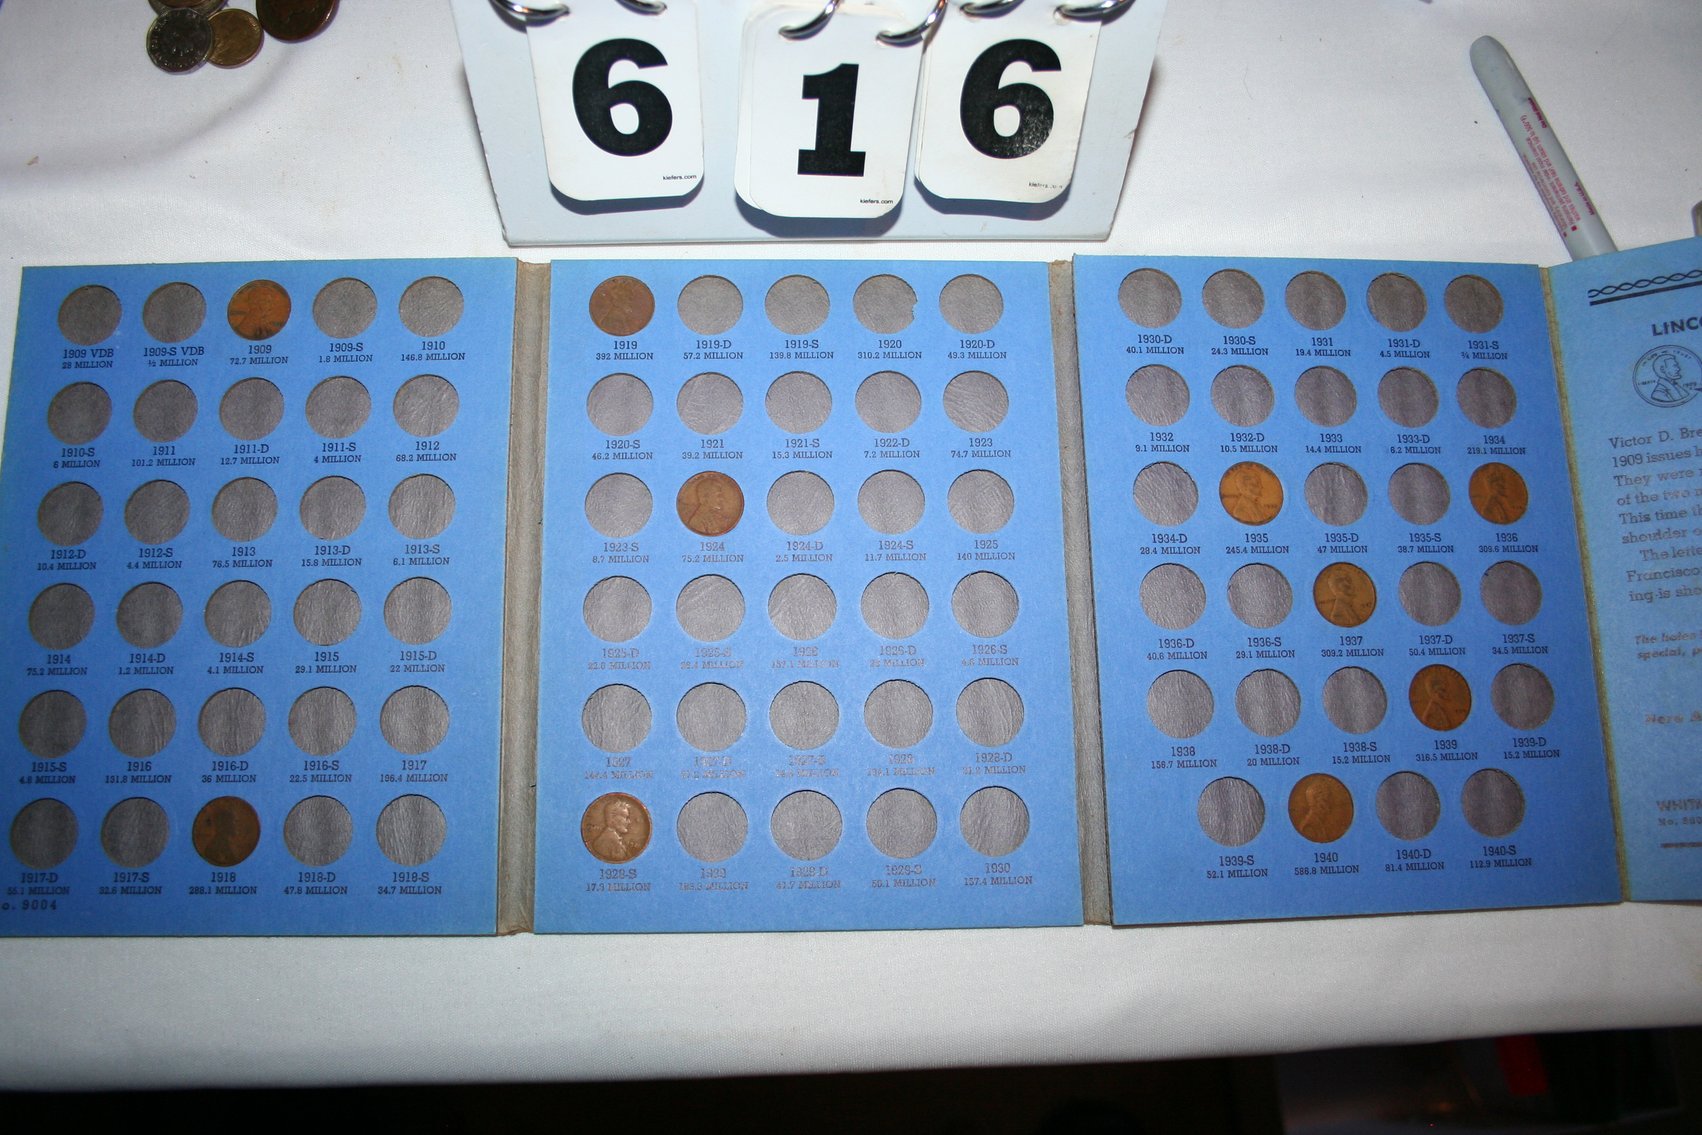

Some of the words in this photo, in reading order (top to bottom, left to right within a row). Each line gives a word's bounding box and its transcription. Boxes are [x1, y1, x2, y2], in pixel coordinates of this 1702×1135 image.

[572, 38, 673, 157] 6
[797, 63, 867, 177] 1
[960, 38, 1062, 159] 6
[1651, 316, 1702, 337] LINC
[614, 340, 638, 350] 1919
[696, 339, 732, 350] 1919-D
[784, 338, 820, 350] 1919-S
[878, 339, 903, 349] 1920
[959, 339, 996, 350] 1920-D
[1137, 334, 1173, 344] 1930-D
[1222, 335, 1257, 346] 1930-S
[1311, 336, 1333, 347] 1931
[1387, 338, 1421, 349] 1931-D
[1467, 339, 1500, 350] 1931-S
[144, 346, 178, 357] 1909-S
[180, 345, 205, 356] VDB
[248, 344, 273, 355] 1909
[329, 342, 364, 353] 1909-S
[421, 340, 446, 351] 1910
[1126, 346, 1143, 354] 40.1
[1146, 346, 1184, 354] MILLION
[1211, 347, 1228, 355] 24.3
[1230, 347, 1269, 356] MILLION
[63, 348, 88, 360] 1909
[90, 348, 114, 358] VDB
[401, 353, 423, 362] 146.8
[425, 352, 466, 361] MILLION
[596, 352, 611, 361] 392
[614, 352, 654, 360] MILLION
[683, 352, 701, 360] 57.2
[704, 351, 744, 360] MILLION
[770, 351, 792, 360] 139.8
[794, 351, 834, 359] MILLION
[857, 351, 880, 359] 310.2
[882, 351, 922, 359] MILLION
[947, 351, 965, 359] 49.3
[967, 351, 1007, 359] MILLION
[229, 357, 247, 365] 72.7
[248, 356, 289, 365] MILLION
[874, 437, 911, 448] 1922-D
[968, 437, 994, 448] 1923
[1150, 431, 1174, 442] 1932
[1230, 432, 1265, 443] 1932-D
[1319, 432, 1344, 444] 1933
[1396, 433, 1431, 444] 1933-D
[1482, 434, 1506, 446] 1934
[1608, 435, 1652, 449] Victor
[1658, 430, 1674, 442] D.
[234, 443, 270, 455] 1911-D
[322, 441, 357, 453] 1911-S
[415, 440, 440, 452] 1912
[605, 438, 641, 450] 1920-S
[700, 438, 724, 449] 1921
[785, 438, 821, 449] 1921-S
[1220, 444, 1238, 453] 10.5
[1239, 444, 1278, 453] MILLION
[62, 446, 96, 458] 1910-S
[153, 445, 176, 456] 1911
[131, 458, 154, 467] 101.2
[156, 457, 196, 466] MILLION
[220, 457, 238, 466] 12.7
[240, 456, 280, 465] MILLION
[395, 454, 414, 462] 68.2
[416, 453, 457, 462] MILLION
[1612, 453, 1643, 468] 1909
[1646, 452, 1691, 463] issues
[1613, 474, 1650, 487] They
[1657, 469, 1694, 481] were
[1617, 493, 1632, 506] of
[1635, 492, 1658, 504] the
[1619, 511, 1651, 525] This
[1655, 509, 1687, 521] time
[1151, 532, 1188, 544] 1934-D
[1244, 532, 1269, 544] 1935
[1324, 532, 1360, 543] 1935-D
[1408, 532, 1442, 543] 1935-S
[1495, 532, 1519, 543] 1936
[1622, 528, 1687, 544] shoulder
[314, 544, 352, 556] 1913-D
[405, 543, 441, 555] 1913-S
[603, 541, 640, 553] 1923-S
[699, 541, 726, 552] 1924
[786, 540, 824, 552] 1924-D
[878, 539, 914, 551] 1924-S
[974, 538, 999, 550] 1925
[1225, 546, 1248, 554] 245.4
[1250, 545, 1289, 554] MILLION
[50, 548, 87, 560] 1912-D
[139, 546, 174, 559] 1912-S
[232, 546, 256, 558] 1913
[1640, 549, 1669, 561] The
[1626, 567, 1700, 582] Francisco
[1158, 637, 1195, 649] 1936-D
[1247, 636, 1282, 648] 1936-S
[1339, 635, 1364, 646] 1937
[1418, 634, 1454, 646] 1937-D
[1502, 632, 1536, 644] 1937-S
[972, 643, 1008, 656] 1926-S
[47, 653, 72, 665] 1914
[130, 652, 166, 664] 1914-D
[219, 651, 255, 664] 1914-S
[314, 650, 340, 663] 1915
[400, 650, 438, 662] 1915-D
[1342, 741, 1378, 753] 1938-S
[1434, 738, 1458, 751] 1939
[1512, 736, 1548, 748] 1939-D
[1170, 745, 1196, 758] 1938
[1254, 743, 1291, 755] 1938-D
[31, 761, 68, 773] 1915-S
[127, 760, 152, 772] 1916
[212, 760, 250, 772] 1916-D
[304, 759, 340, 772] 1916-S
[401, 759, 428, 771] 1917
[1396, 848, 1432, 860] 1940-D
[1482, 844, 1517, 857] 1940-S
[1218, 854, 1255, 867] 1939-S
[1313, 851, 1339, 864] 1940
[985, 862, 1011, 874] 1930
[1206, 870, 1224, 879] 52.1
[1227, 868, 1268, 878] MILLION
[21, 872, 59, 884] 1917-D
[114, 871, 150, 884] 1917-S
[211, 871, 237, 884] 1918
[298, 871, 337, 883] 1918-D
[392, 871, 430, 883] 1918-S
[22, 899, 57, 911] 9004
